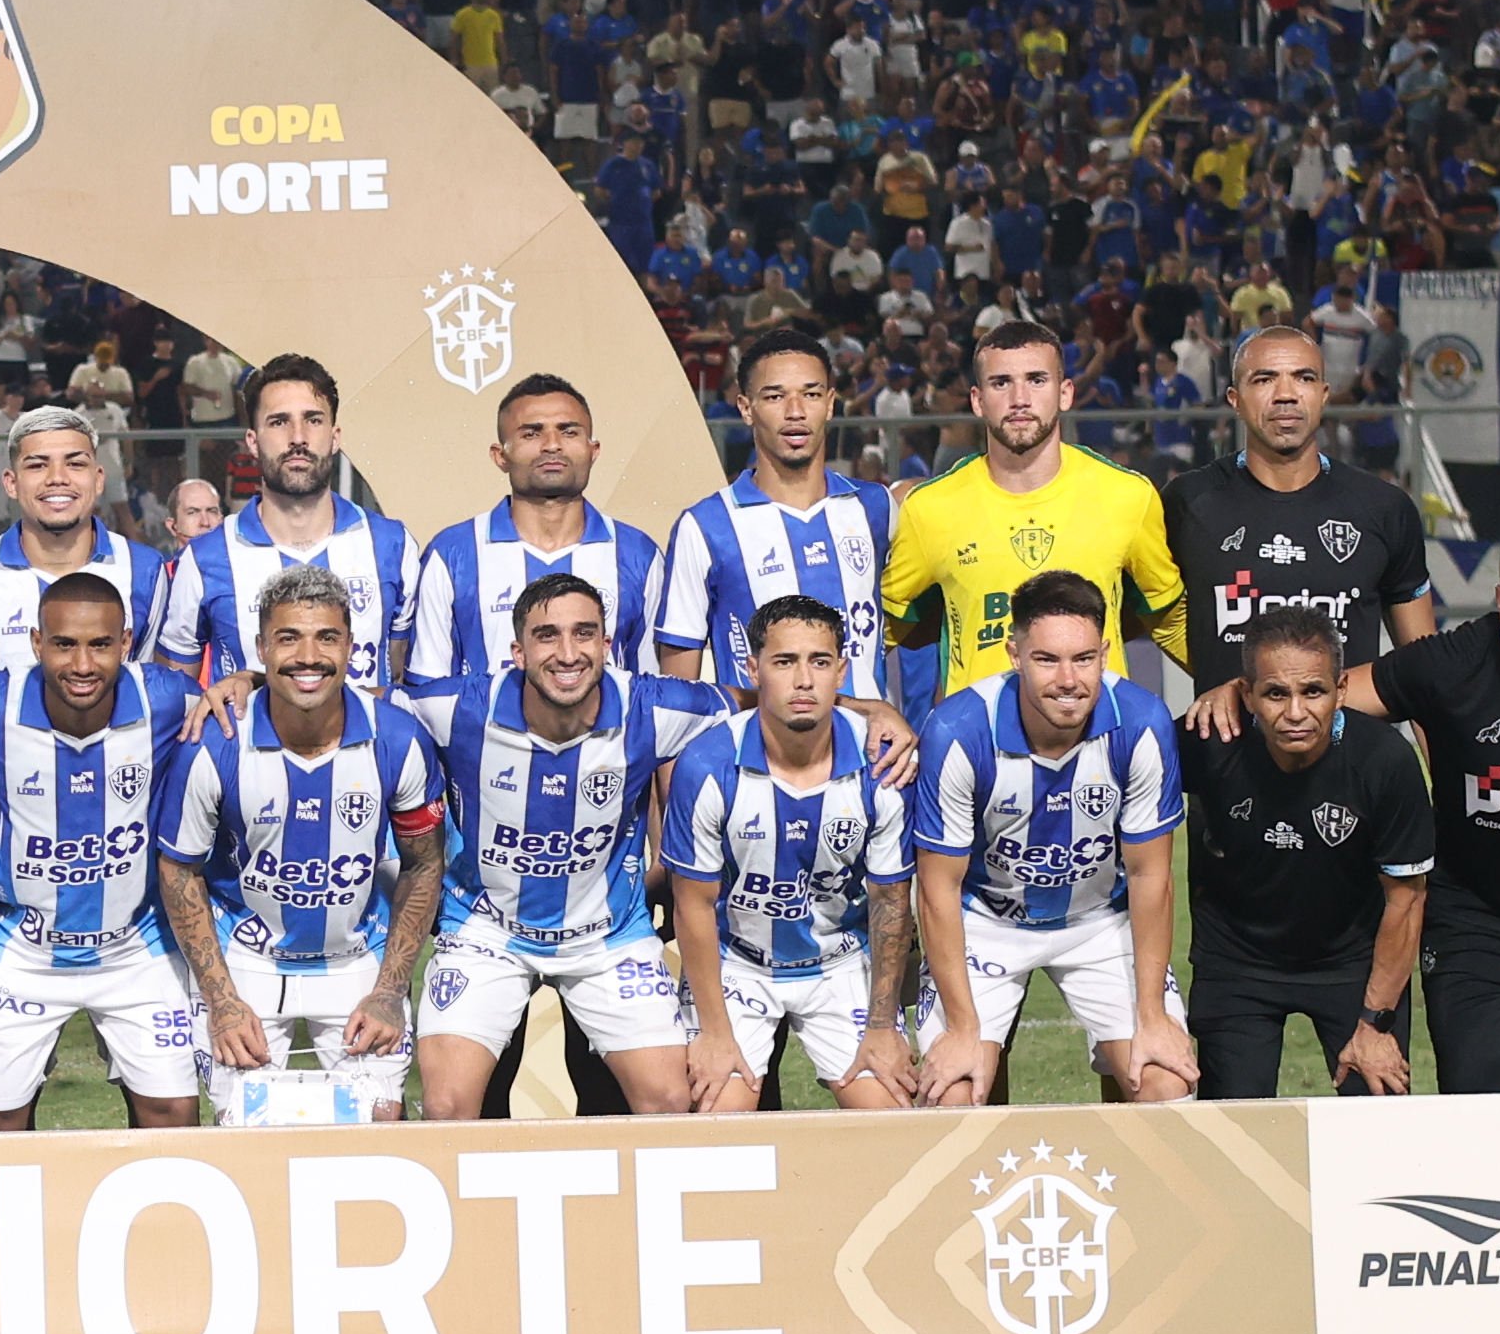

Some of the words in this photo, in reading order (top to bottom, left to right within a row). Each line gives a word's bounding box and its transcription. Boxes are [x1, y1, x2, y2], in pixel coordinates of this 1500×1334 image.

[210, 103, 345, 147] COPA
[169, 159, 390, 216] NORTE
[456, 327, 488, 343] CBF
[1258, 548, 1307, 561] CHEFE
[757, 564, 785, 577] LOBO
[1, 626, 28, 636] LOBO
[26, 835, 101, 860] Bet
[493, 823, 566, 855] Bet
[481, 848, 508, 866] dá
[512, 855, 596, 877] Sorte
[996, 834, 1068, 869] Bet
[16, 862, 43, 878] dá
[48, 861, 131, 884] Sorte
[255, 851, 324, 885] Bet
[1013, 863, 1098, 887] Sorte
[244, 875, 268, 893] dá
[272, 885, 355, 908] Sorte
[732, 894, 759, 910] dá
[46, 927, 128, 947] Banpa
[509, 914, 614, 942] Banpará
[152, 1010, 190, 1028] SE
[1022, 1247, 1070, 1268] CBF
